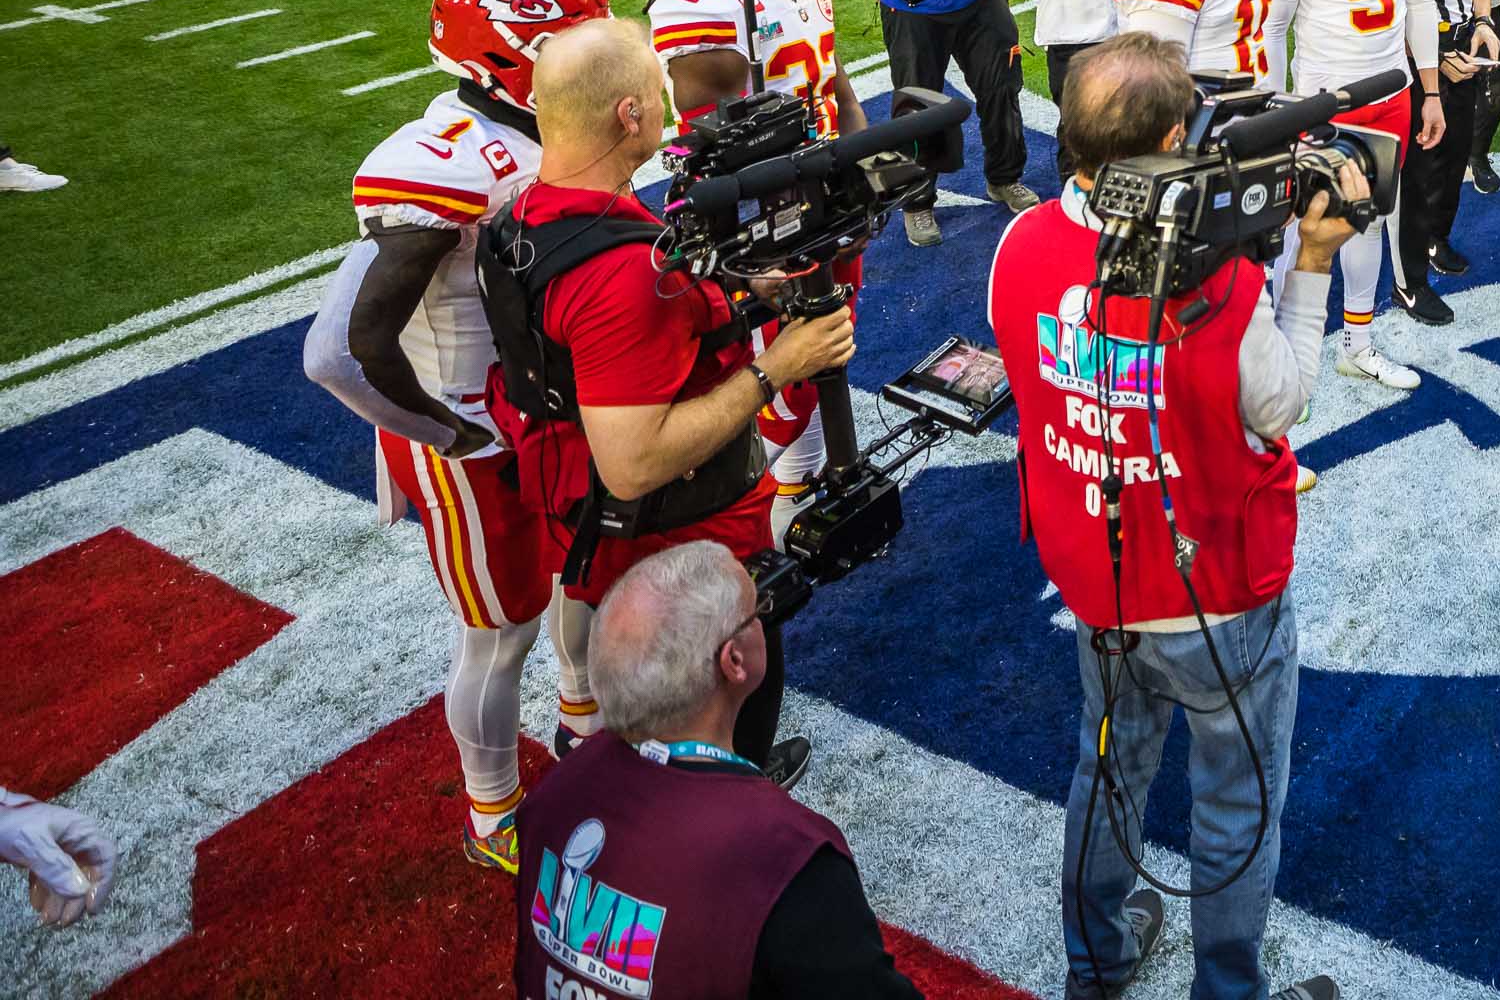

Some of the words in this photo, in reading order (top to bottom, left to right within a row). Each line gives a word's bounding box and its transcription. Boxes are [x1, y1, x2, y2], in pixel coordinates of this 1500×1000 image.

[432, 118, 473, 143] 1
[485, 142, 514, 172] C
[1051, 371, 1097, 392] SUPER
[1065, 393, 1128, 445] FOX
[1044, 423, 1183, 485] CAMERA
[538, 927, 581, 967] SUPER
[587, 961, 634, 993] BOWL
